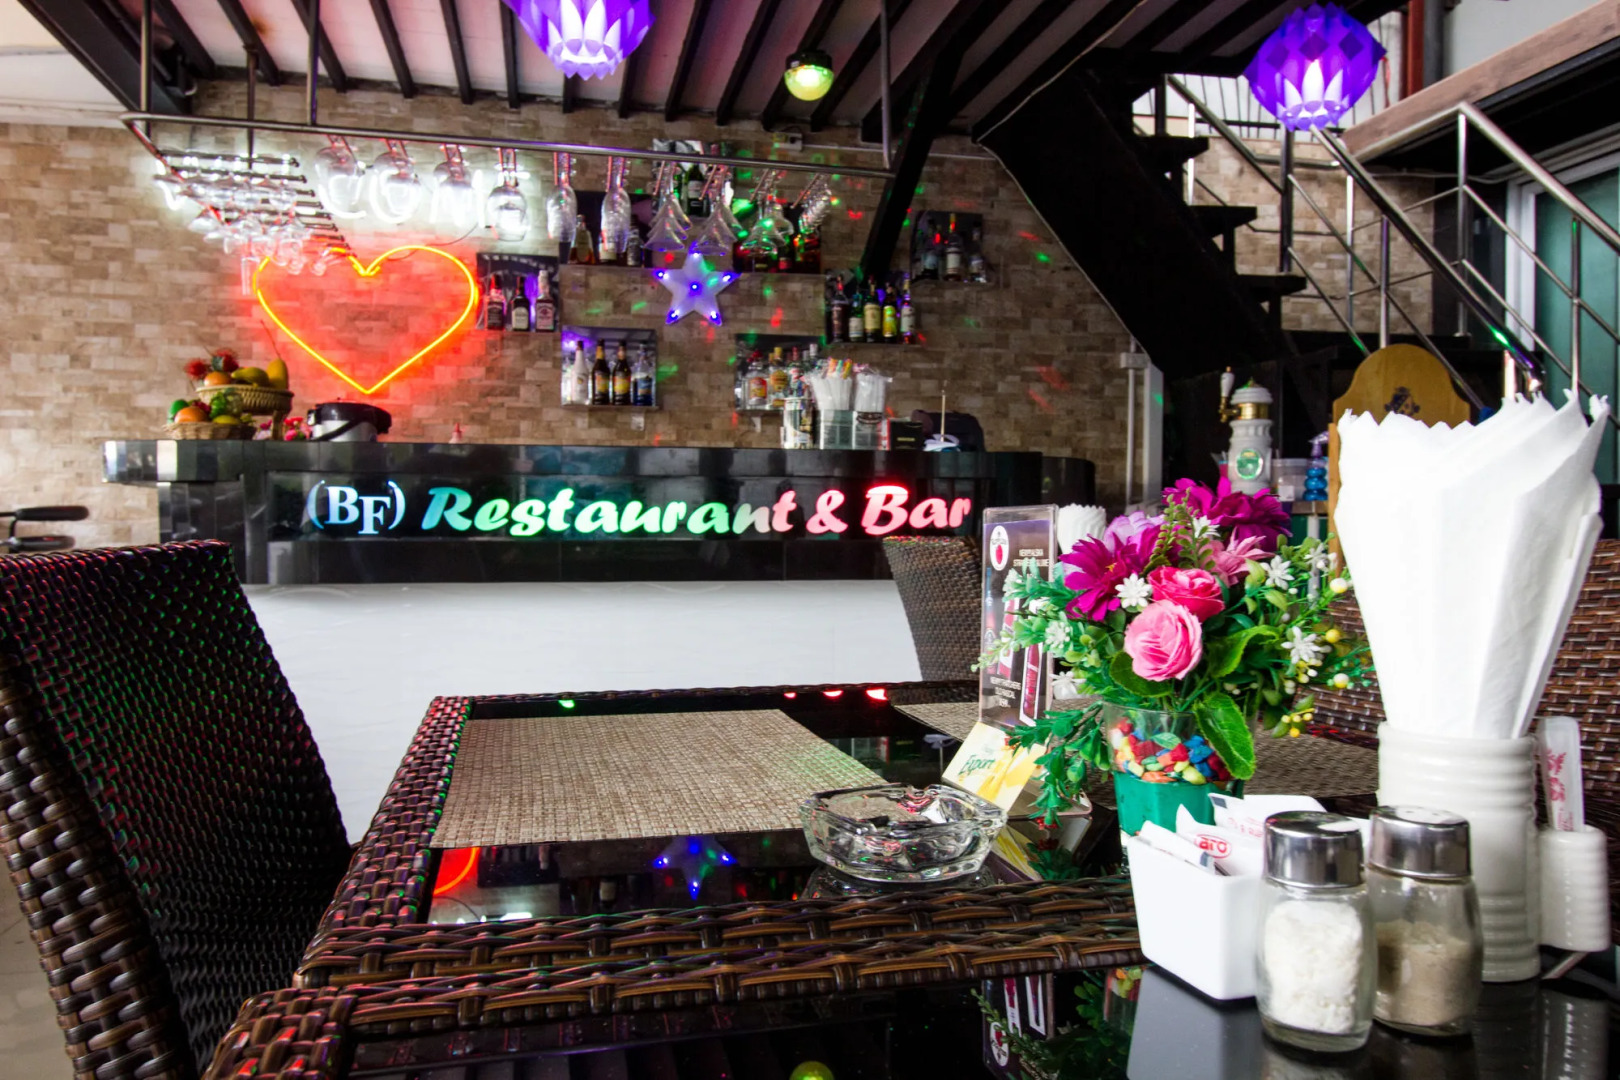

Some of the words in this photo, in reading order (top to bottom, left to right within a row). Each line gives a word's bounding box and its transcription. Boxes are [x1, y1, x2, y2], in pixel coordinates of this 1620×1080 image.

[421, 486, 797, 536] Restaurant
[806, 490, 848, 534] &
[861, 486, 971, 535] Bar
